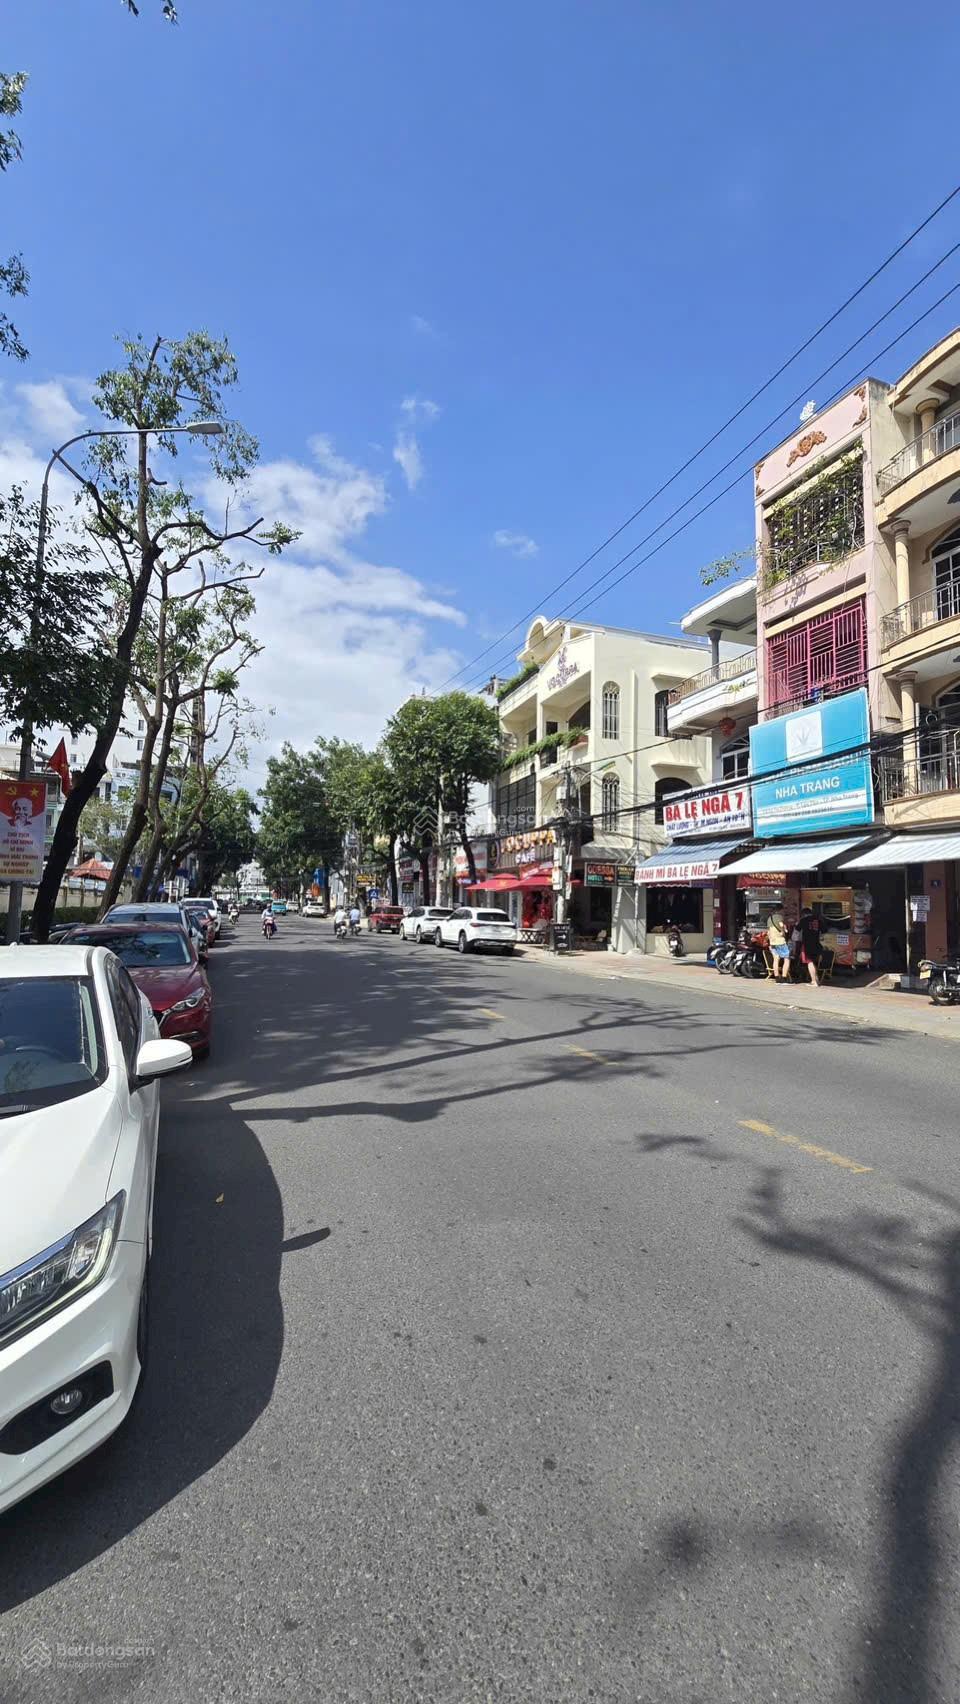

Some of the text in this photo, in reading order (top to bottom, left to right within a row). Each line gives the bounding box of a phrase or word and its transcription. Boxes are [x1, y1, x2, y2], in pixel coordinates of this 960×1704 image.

[775, 775, 841, 800] NHA TRANG
[665, 805, 682, 822] BA
[684, 801, 698, 820] LẸ
[734, 791, 743, 811] 7
[656, 866, 665, 879] MÌ
[667, 866, 677, 878] BA
[680, 865, 689, 880] LẸ
[712, 863, 718, 872] 7
